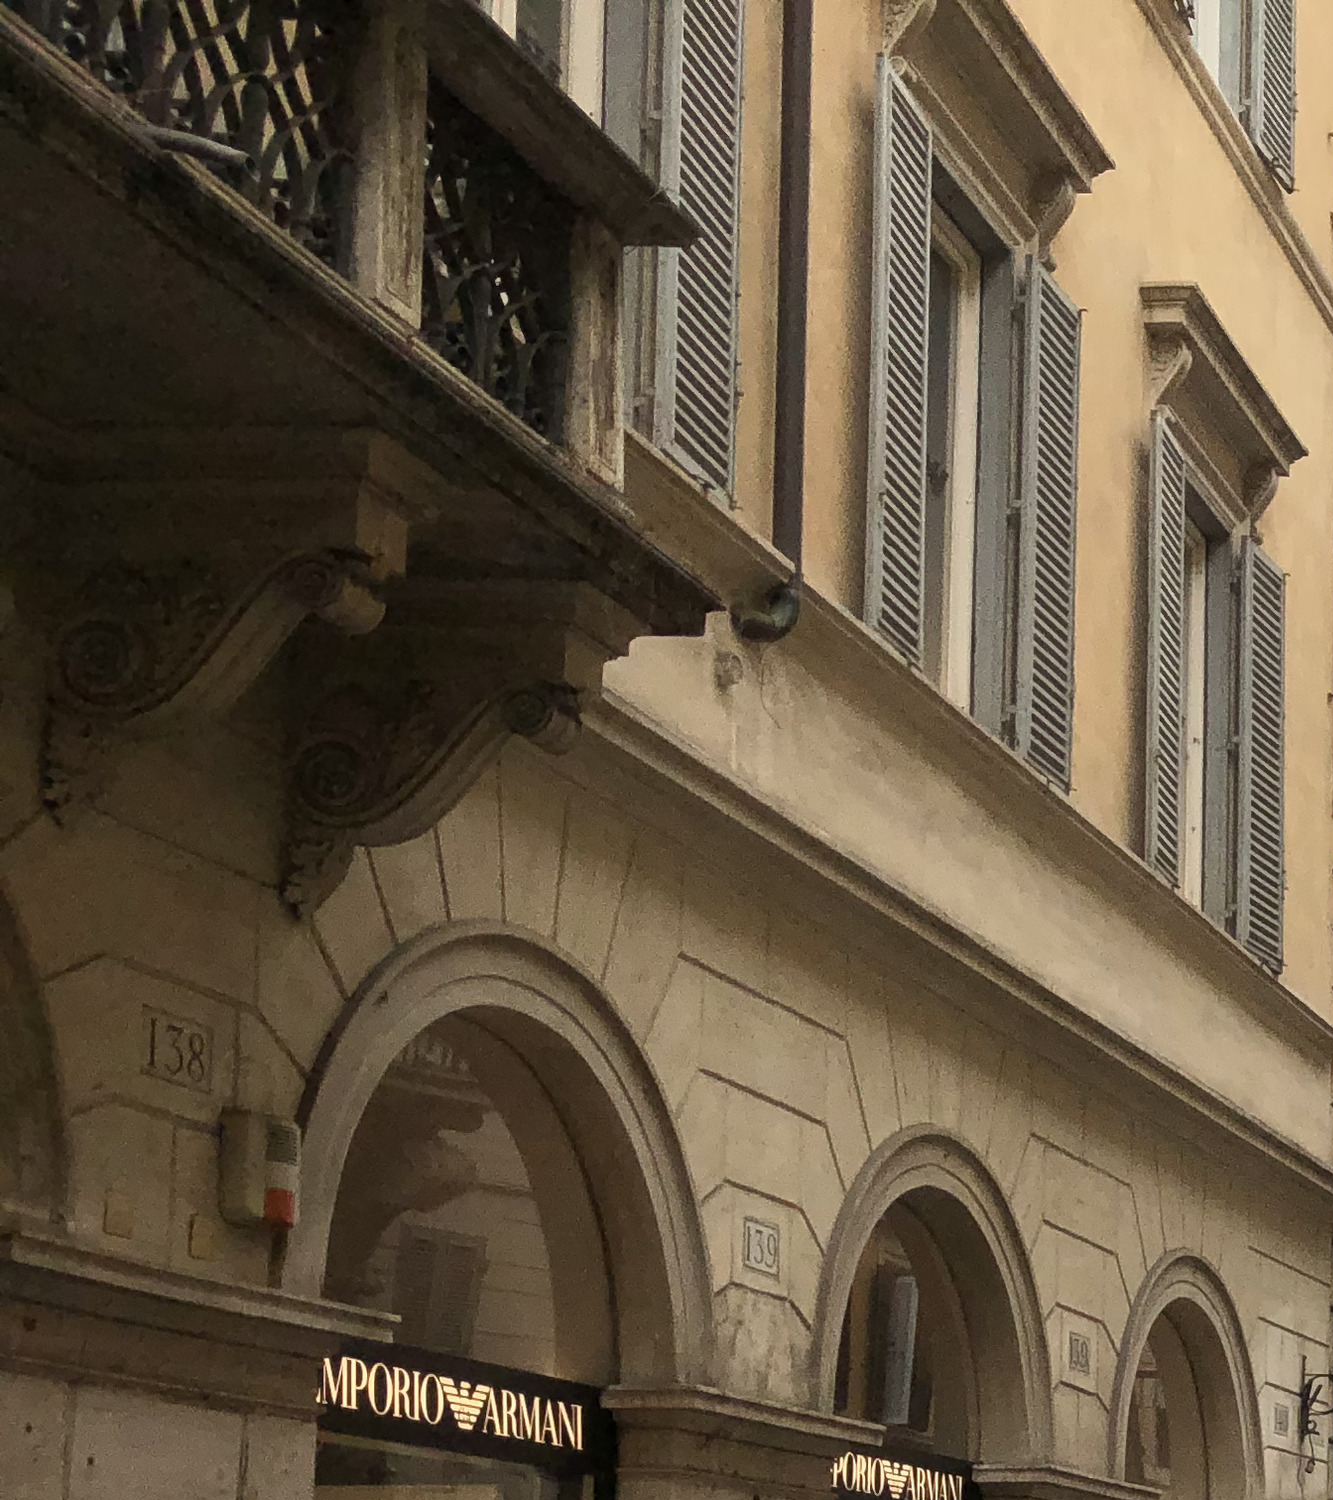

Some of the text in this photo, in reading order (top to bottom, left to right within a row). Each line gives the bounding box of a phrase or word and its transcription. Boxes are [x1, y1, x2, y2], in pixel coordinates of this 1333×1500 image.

[147, 1017, 205, 1082] 138
[746, 1225, 777, 1268] 139
[315, 1356, 584, 1450] MPORIO ARMANI
[831, 1451, 885, 1496] PORIO
